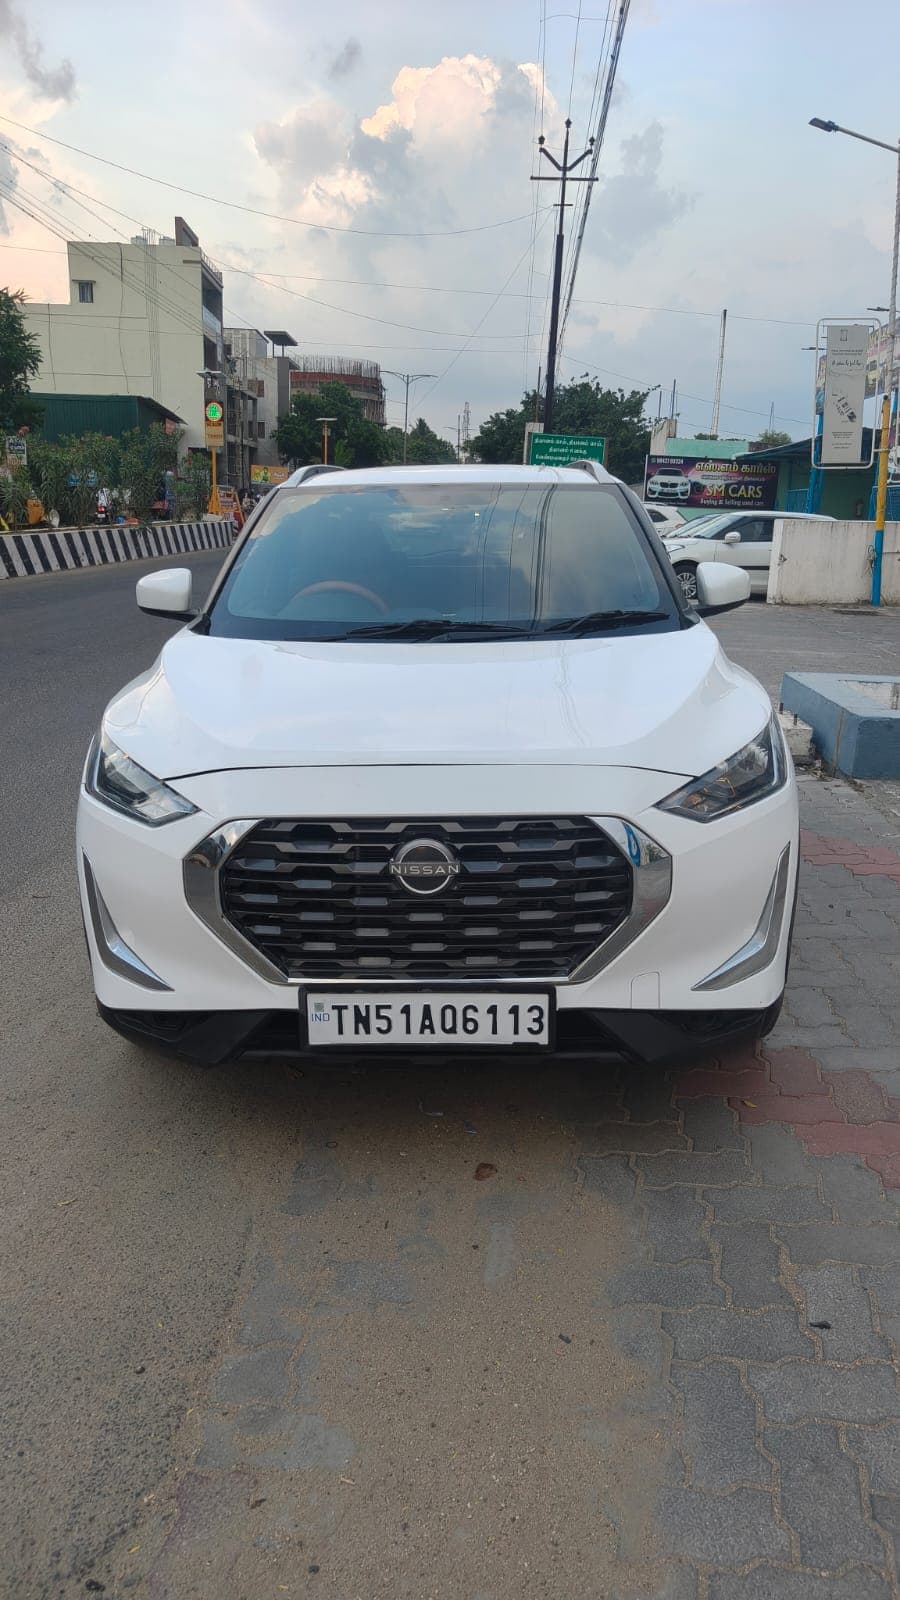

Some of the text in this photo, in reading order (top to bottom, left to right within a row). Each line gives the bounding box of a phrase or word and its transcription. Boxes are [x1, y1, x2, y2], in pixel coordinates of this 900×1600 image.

[706, 484, 763, 498] SM CARS
[390, 864, 459, 875] NISSAN
[311, 1004, 545, 1036] IND TN51AQ6113
